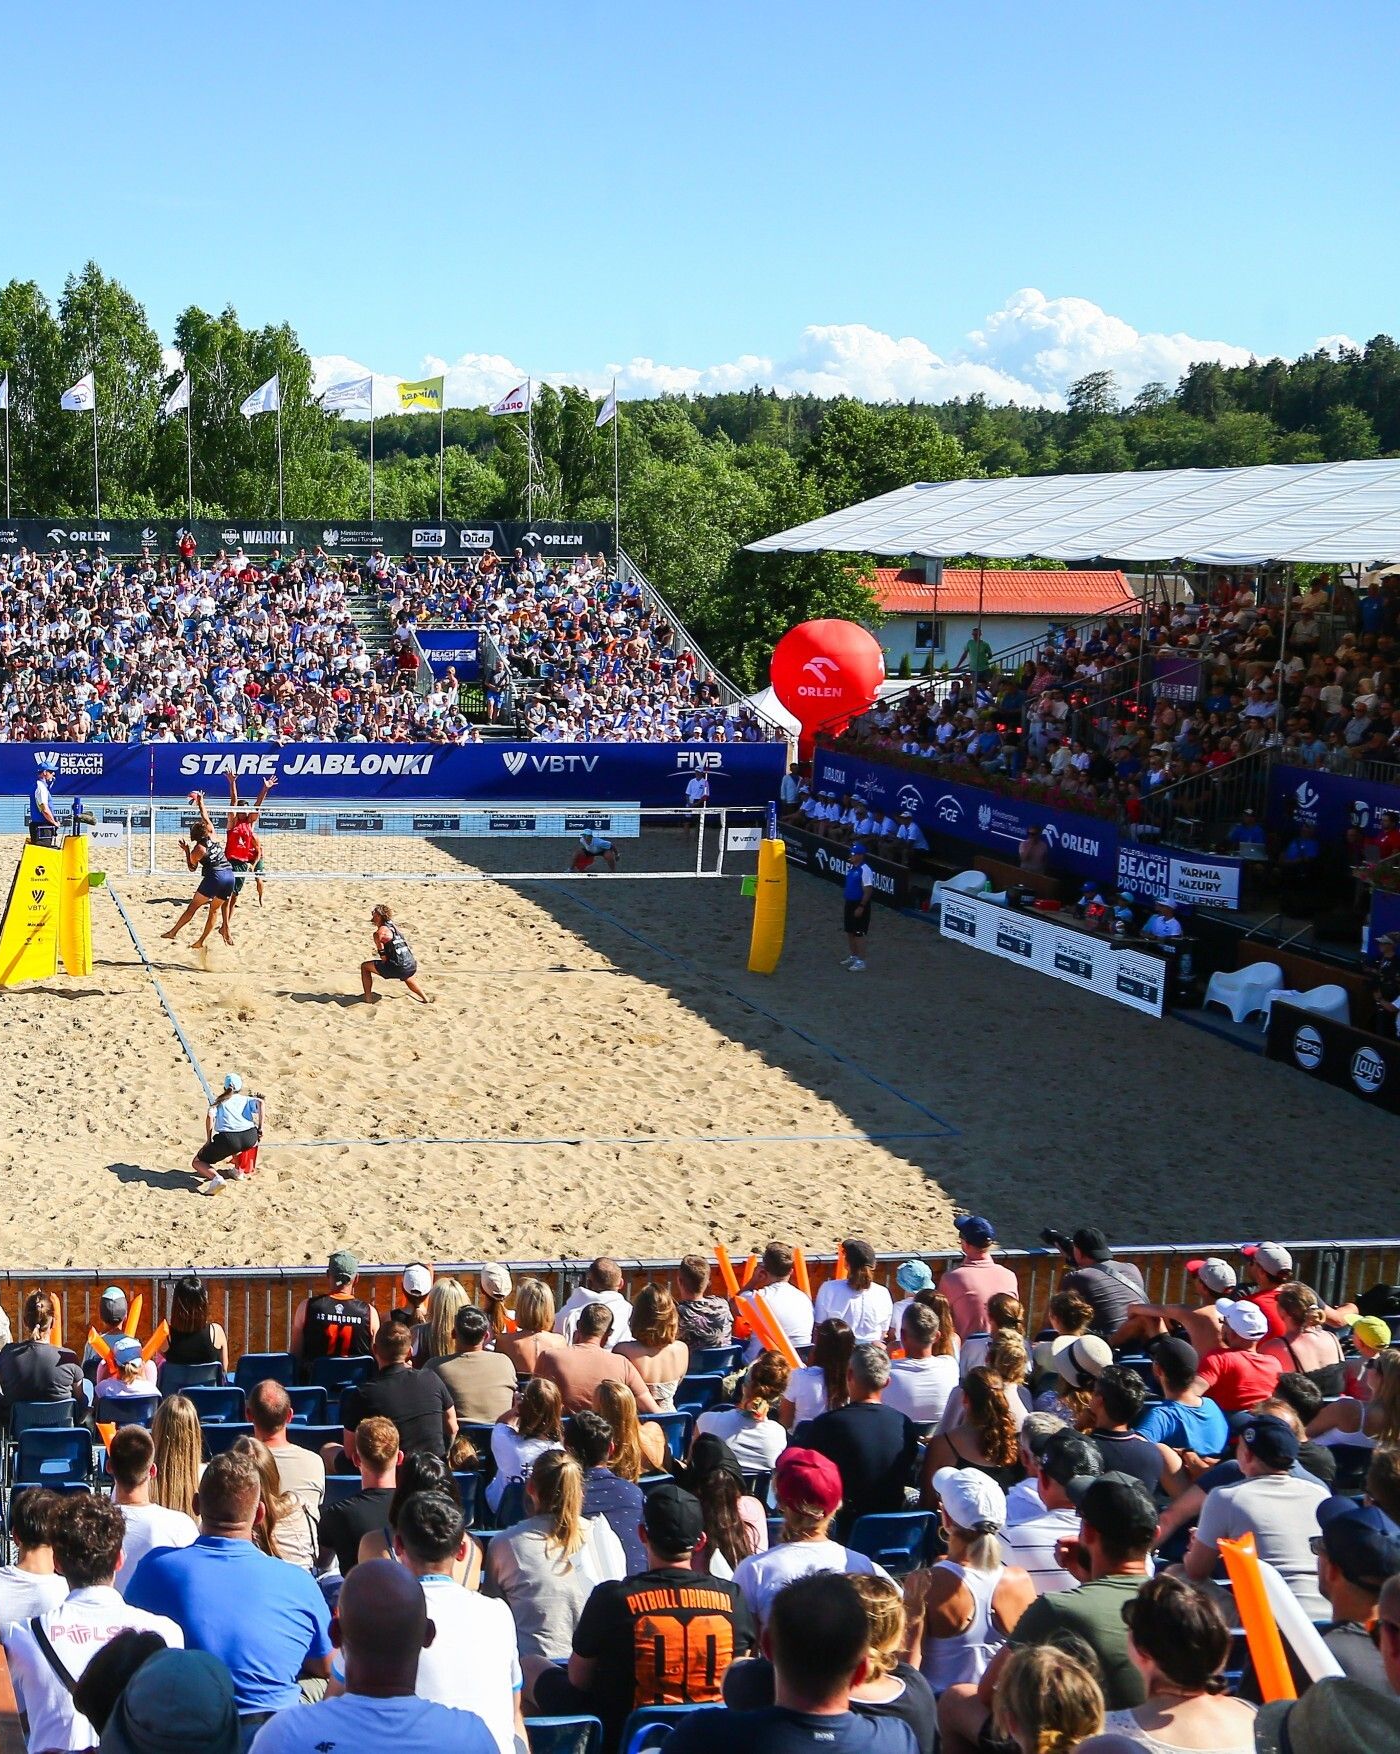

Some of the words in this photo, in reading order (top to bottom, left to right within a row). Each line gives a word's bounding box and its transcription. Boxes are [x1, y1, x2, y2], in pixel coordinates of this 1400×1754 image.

[70, 531, 111, 542] ORLEN
[243, 530, 287, 544] WARKA
[543, 535, 583, 545] ORLEN
[797, 686, 842, 697] ORLEN
[60, 757, 103, 767] BEACH
[180, 754, 279, 775] STARE
[283, 754, 434, 775] JABŁONKI
[531, 756, 600, 772] VBTV
[676, 752, 722, 768] FIVB
[900, 795, 919, 811] PGE
[938, 807, 958, 823] PGE
[1061, 832, 1099, 857] ORLEN
[1120, 846, 1148, 859] VOLLEYBALL
[1149, 853, 1169, 863] WORLD
[1118, 854, 1168, 884] BEACH
[1180, 865, 1221, 880] WARMIA
[1117, 874, 1139, 892] PRO
[1138, 880, 1167, 898] TOUR
[1179, 880, 1222, 893] MAZURY
[1173, 891, 1229, 908] CHALLENGE
[1296, 1038, 1321, 1055] PEPSI
[324, 1323, 353, 1358] 11
[626, 1589, 679, 1615] PITBULL
[680, 1588, 733, 1613] ORIGINAL
